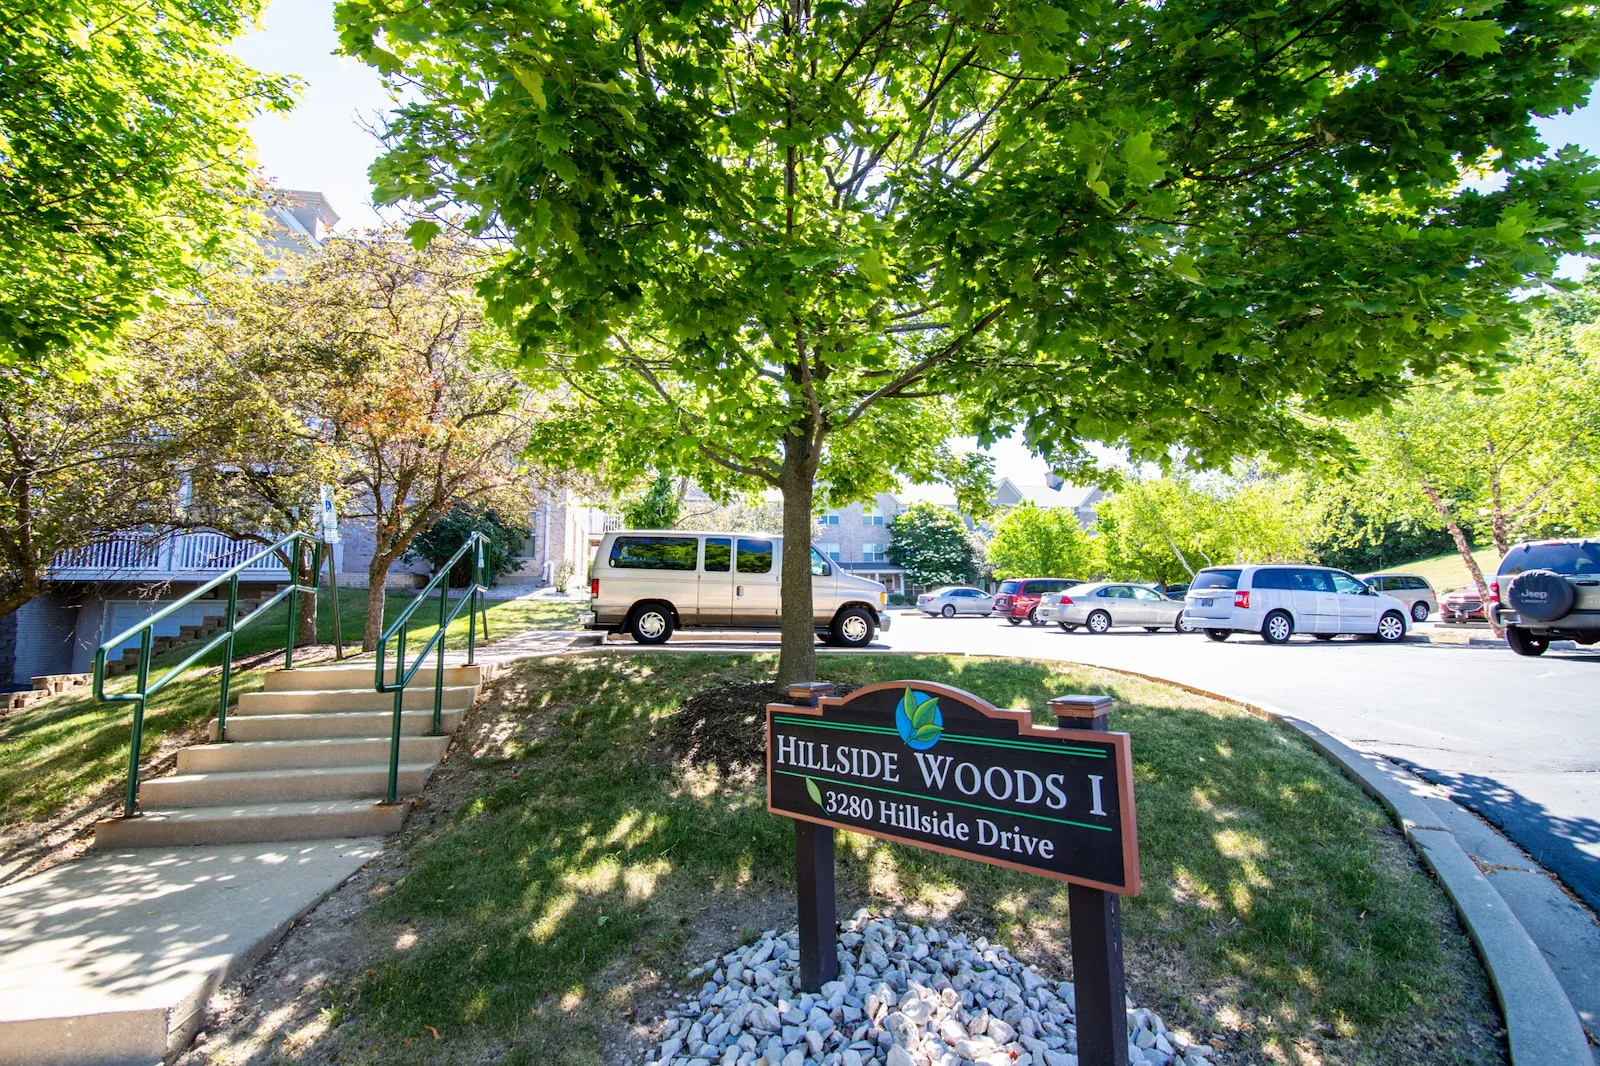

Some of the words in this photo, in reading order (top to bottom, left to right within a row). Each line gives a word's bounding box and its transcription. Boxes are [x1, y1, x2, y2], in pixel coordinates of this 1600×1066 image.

[1521, 589, 1547, 599] Jeep
[776, 734, 900, 783] HILLSIDE
[914, 752, 1067, 810] WOODS
[1087, 774, 1108, 817] I
[825, 790, 874, 820] 3280
[879, 800, 970, 842] Hillside
[975, 818, 1055, 860] Drive
